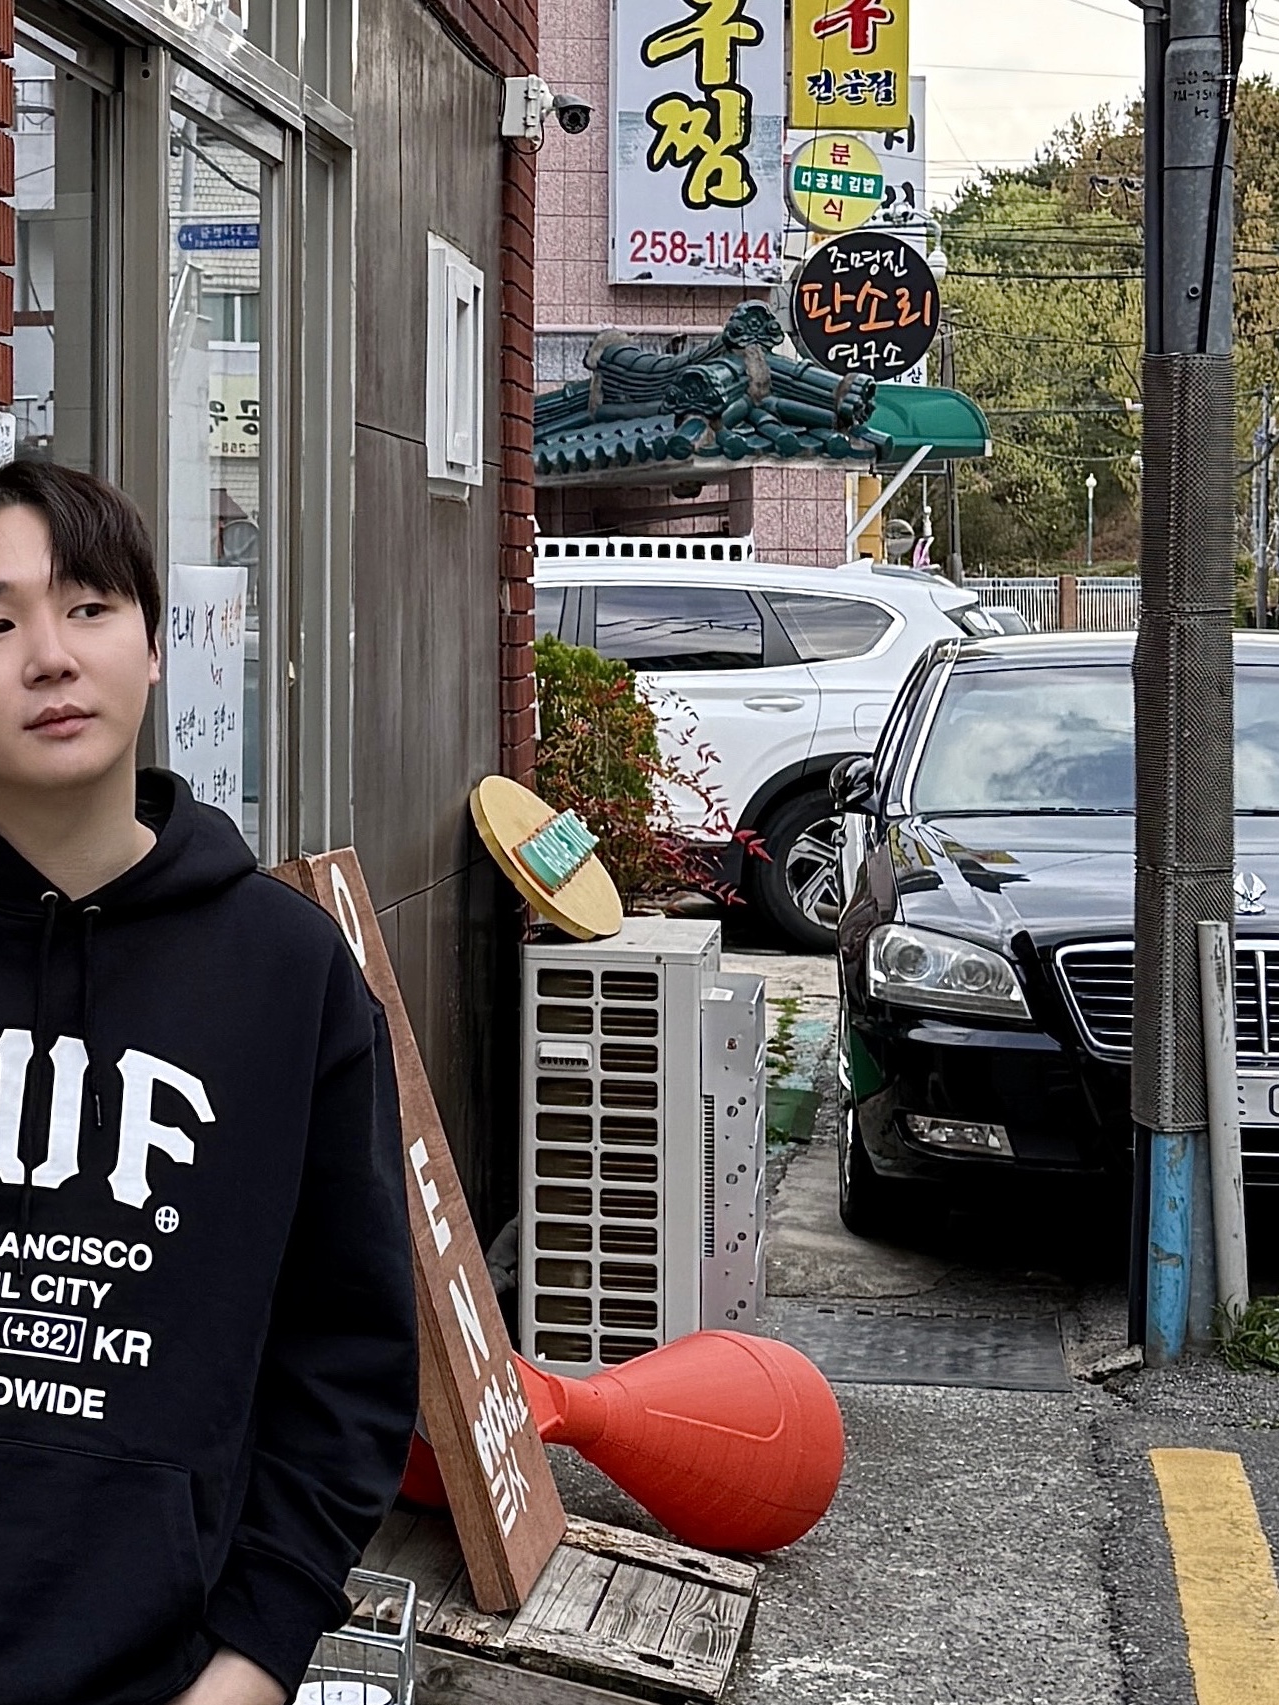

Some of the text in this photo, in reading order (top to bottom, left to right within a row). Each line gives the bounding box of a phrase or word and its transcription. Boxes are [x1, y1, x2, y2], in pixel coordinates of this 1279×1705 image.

[629, 229, 772, 264] 258-1144
[827, 245, 908, 278] 조명진
[800, 279, 932, 334] 판소리
[827, 340, 906, 370] 연구소
[30, 1274, 113, 1309] CITY
[92, 1325, 153, 1367] KR
